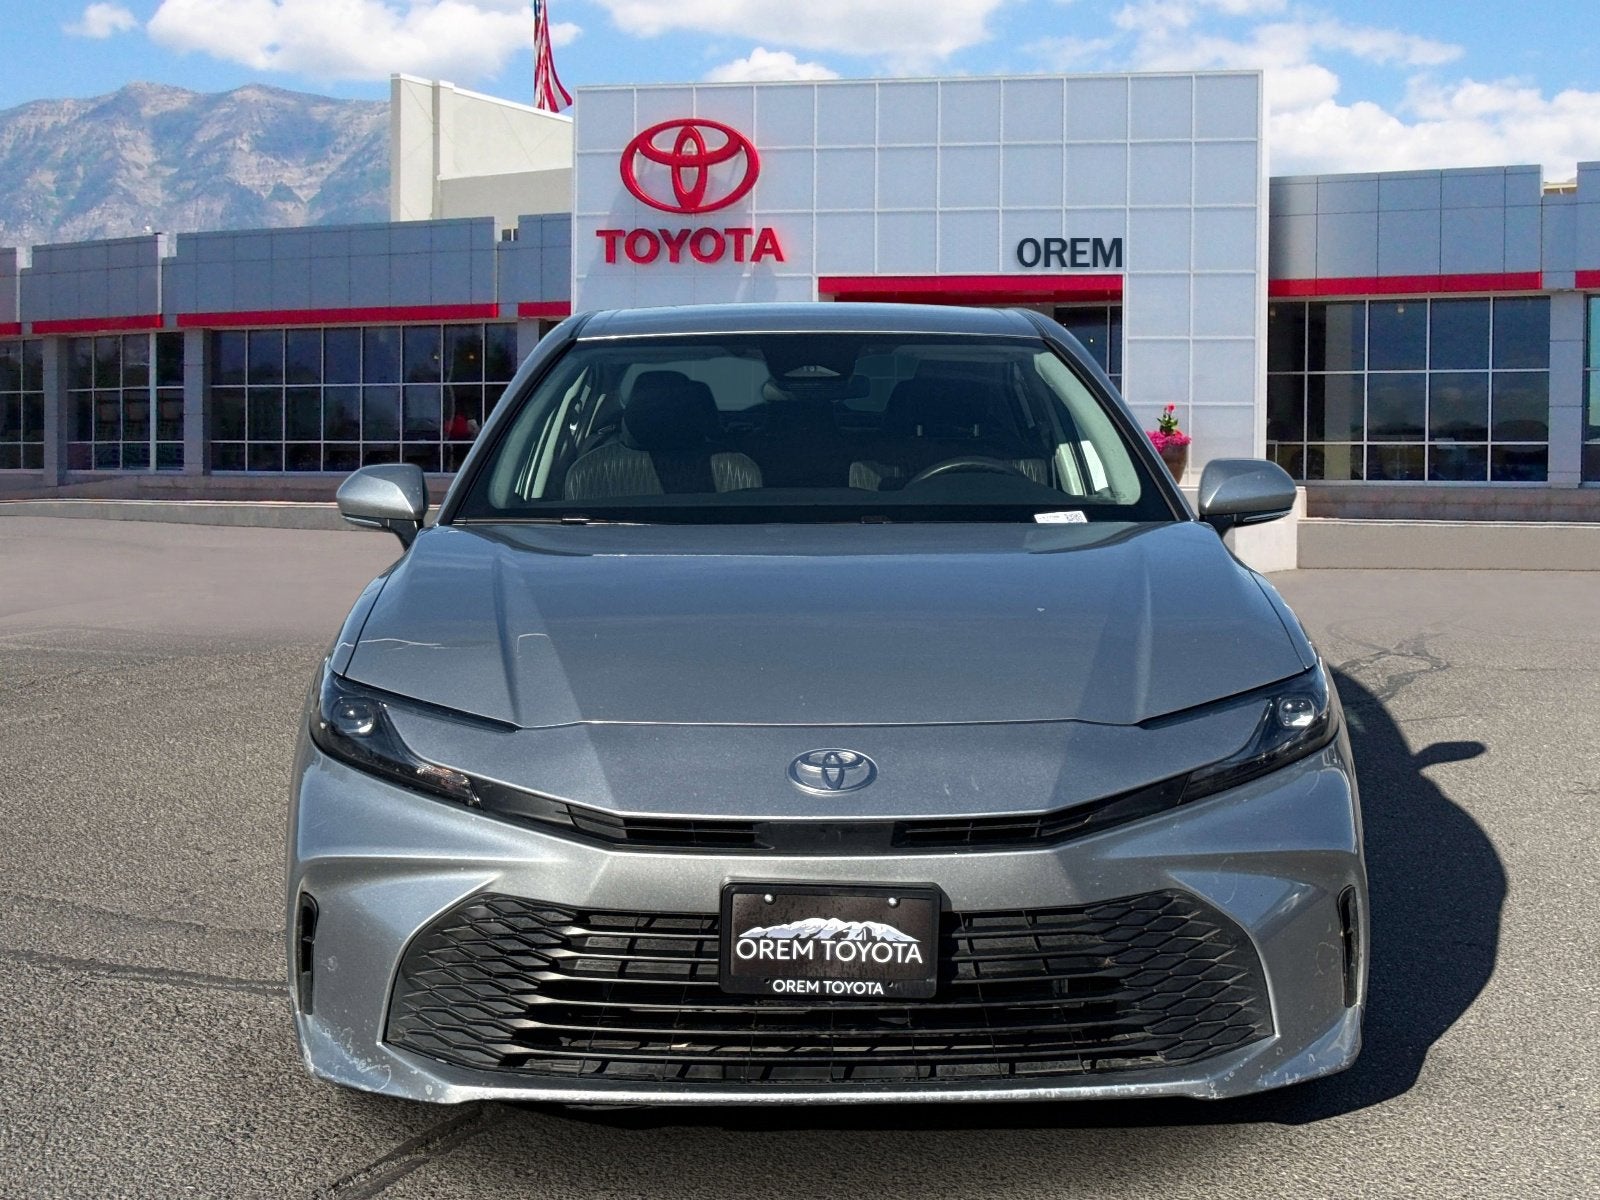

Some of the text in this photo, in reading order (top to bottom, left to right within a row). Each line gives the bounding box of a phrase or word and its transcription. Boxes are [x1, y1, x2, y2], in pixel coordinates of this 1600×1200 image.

[596, 227, 785, 264] TOYOTA
[1016, 237, 1123, 268] OREM
[736, 938, 923, 964] OREM TOYOTA
[772, 979, 884, 995] OREM TOYOTA
